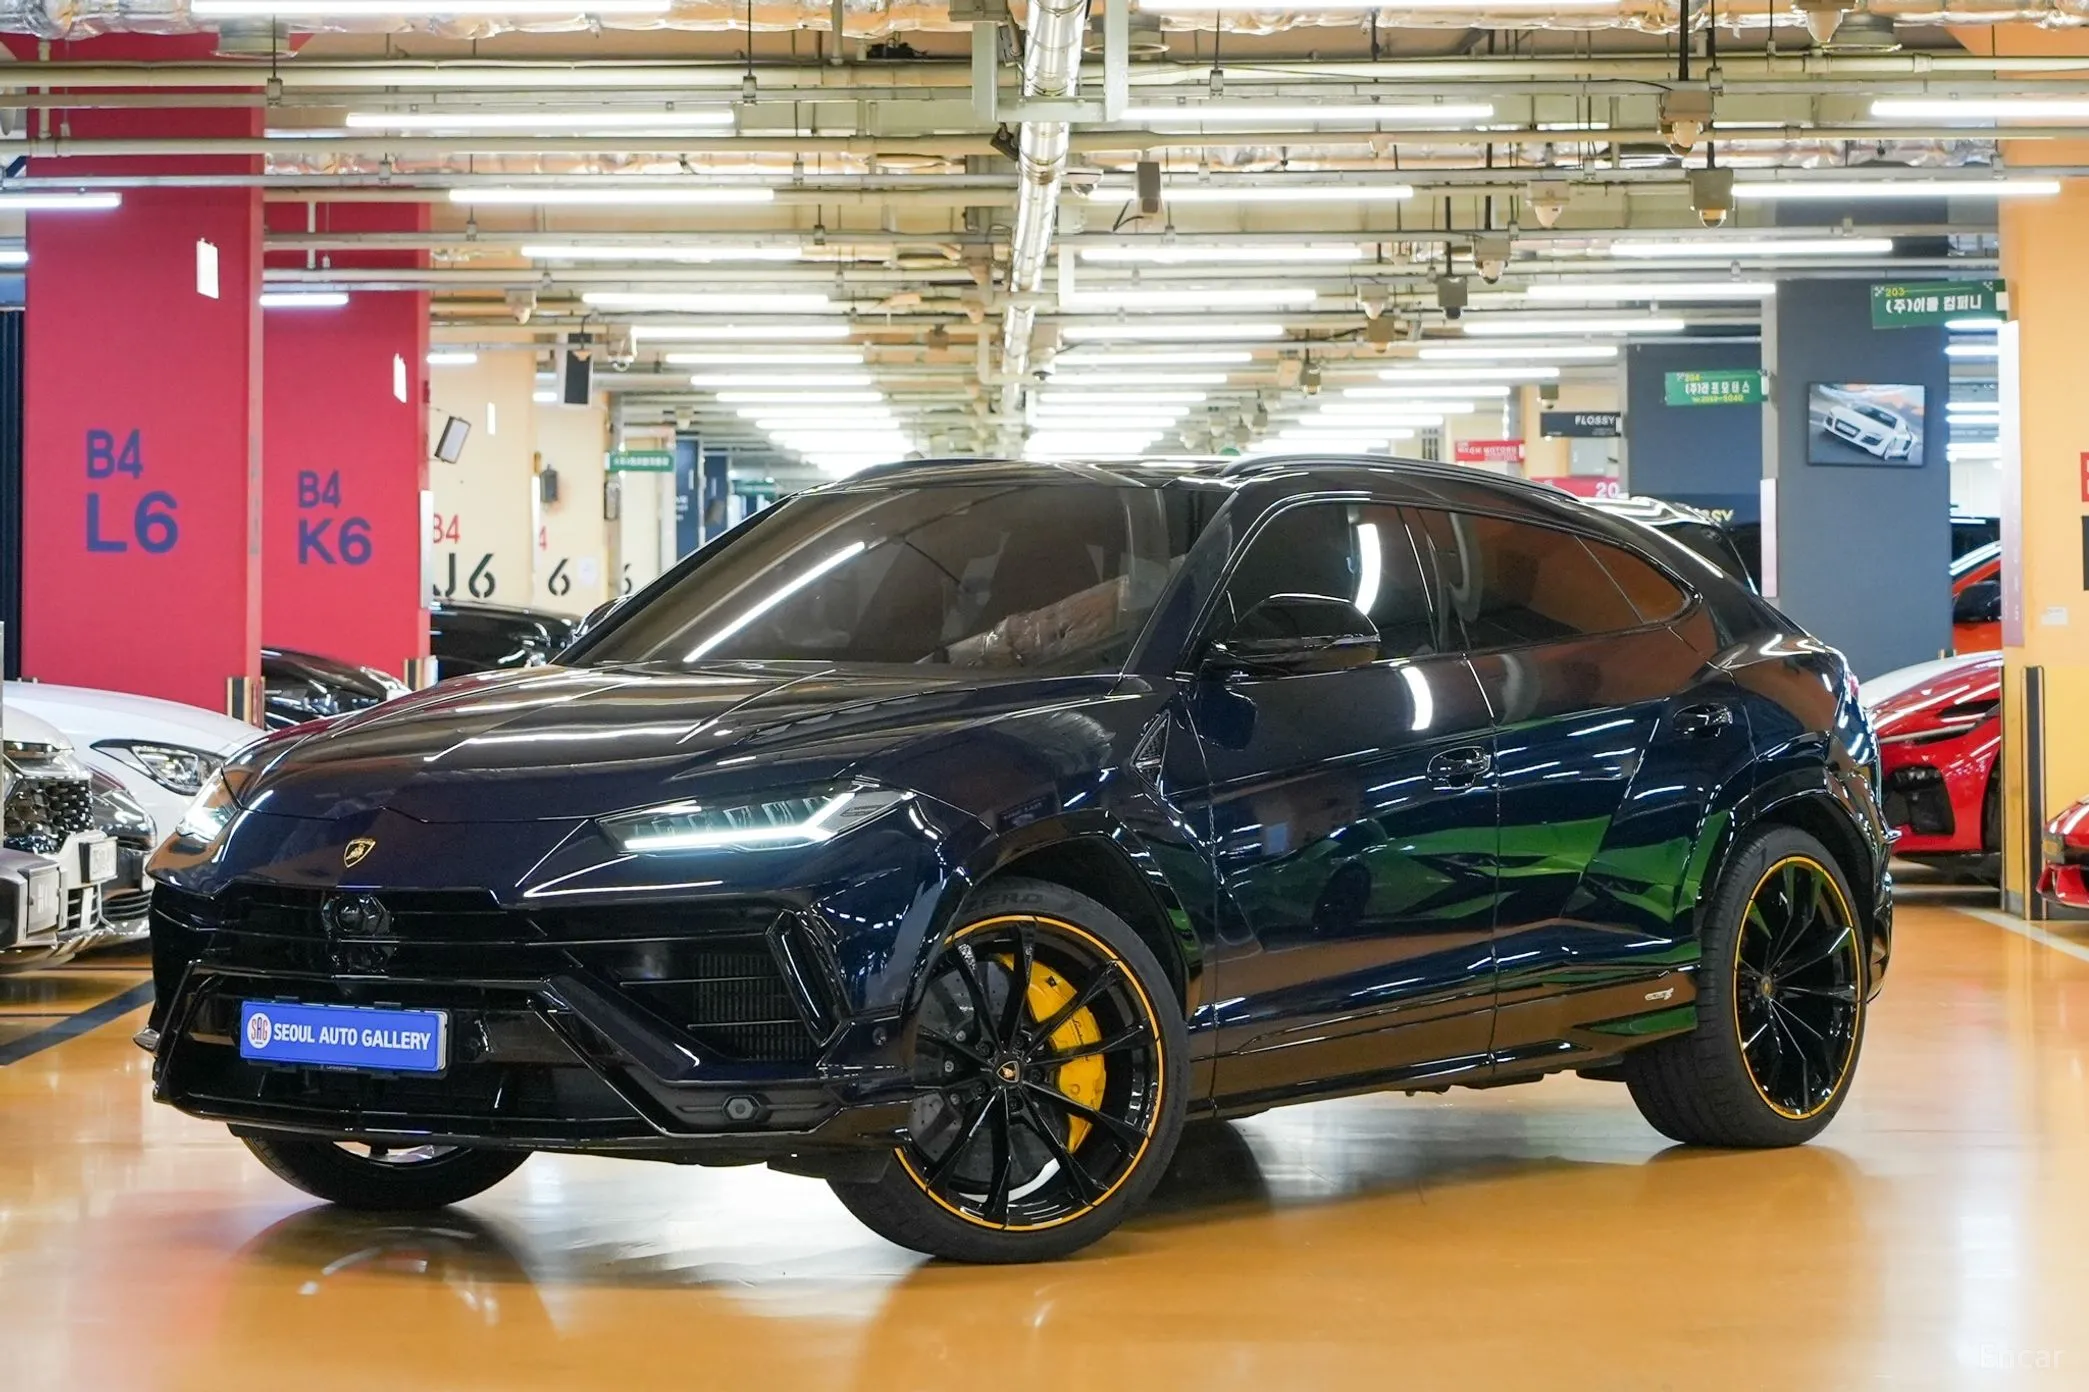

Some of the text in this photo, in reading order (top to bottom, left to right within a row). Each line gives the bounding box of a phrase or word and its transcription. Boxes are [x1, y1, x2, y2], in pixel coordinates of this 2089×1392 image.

[1574, 415, 1615, 426] FLOSSY
[86, 428, 144, 480] B4
[297, 468, 342, 509] B4
[86, 491, 179, 554] L6
[298, 517, 373, 566] K6
[548, 558, 571, 596] 6
[251, 1016, 269, 1041] SAG
[273, 1023, 431, 1051] SEOUL AUTO GALLERY
